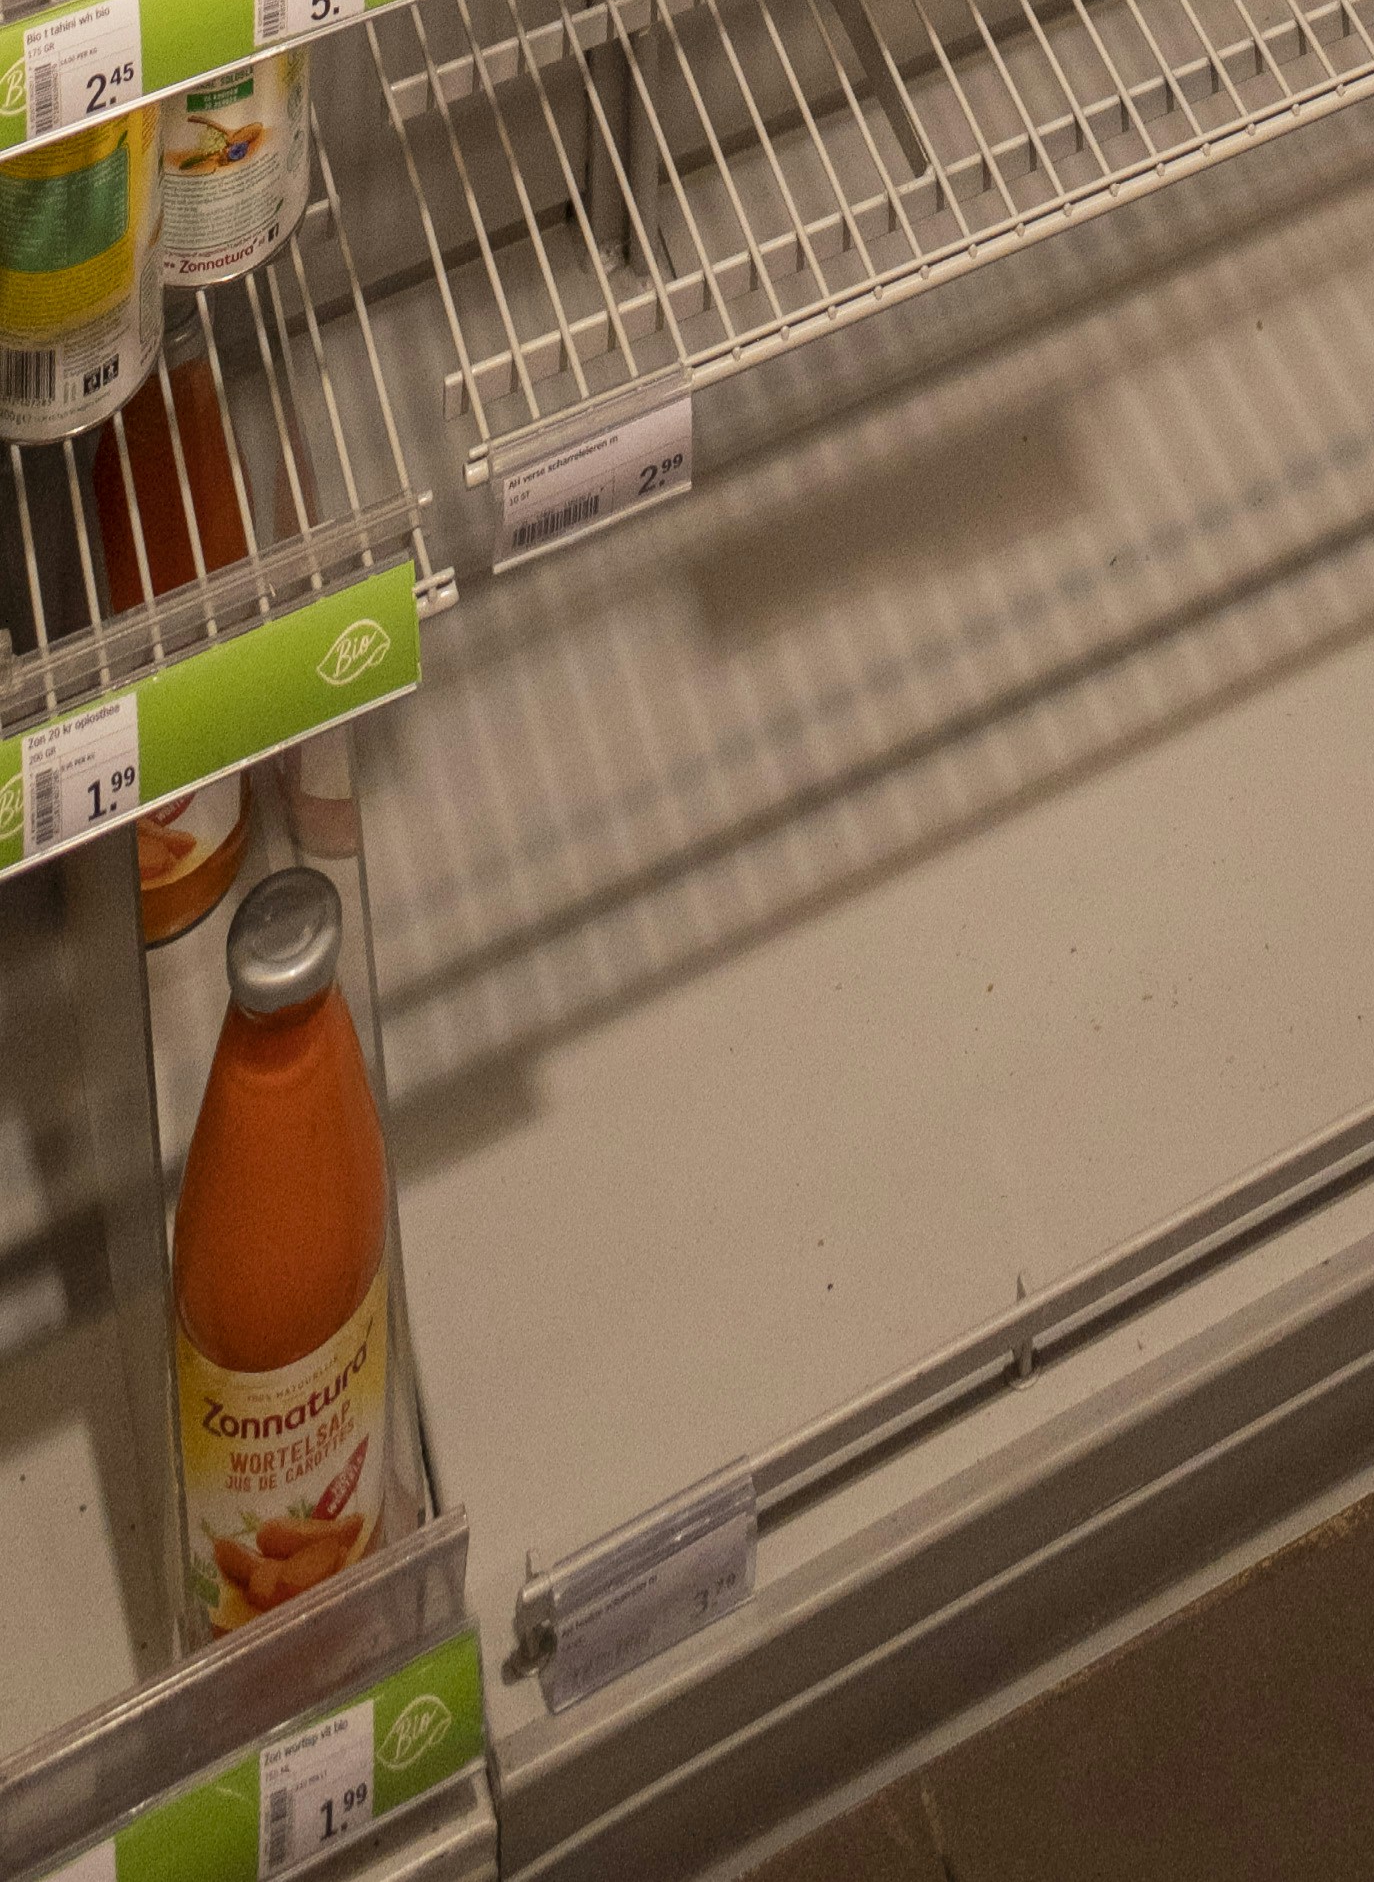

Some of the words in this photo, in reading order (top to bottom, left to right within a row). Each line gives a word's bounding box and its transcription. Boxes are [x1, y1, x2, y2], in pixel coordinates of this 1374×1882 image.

[26, 34, 41, 46] Bio
[50, 18, 76, 36] tahini
[79, 14, 93, 26] wh
[95, 5, 110, 19] bio
[28, 48, 43, 59] 175
[44, 42, 55, 52] GR
[89, 47, 98, 56] KG
[86, 62, 135, 114] 2.45
[179, 238, 259, 275] Zonnatura
[508, 478, 520, 490] AH
[522, 467, 545, 484] verse
[548, 440, 608, 472] scharreleieren
[638, 453, 684, 496] 2.99
[334, 633, 375, 681] Bio
[28, 733, 47, 750] Zon
[48, 728, 61, 742] 20
[63, 720, 73, 734] kr
[75, 703, 121, 732] oplosthee
[29, 752, 44, 766] 200
[87, 766, 136, 822] 1.99
[202, 1338, 369, 1440] Zonnatura
[226, 1475, 251, 1492] JUS
[259, 1475, 278, 1492] DE
[286, 1419, 356, 1484] CAROTTES
[231, 1399, 351, 1475] WORTELSAP
[334, 1718, 348, 1732] bio
[395, 1707, 437, 1761] Bio
[320, 1782, 369, 1842] 1.99
